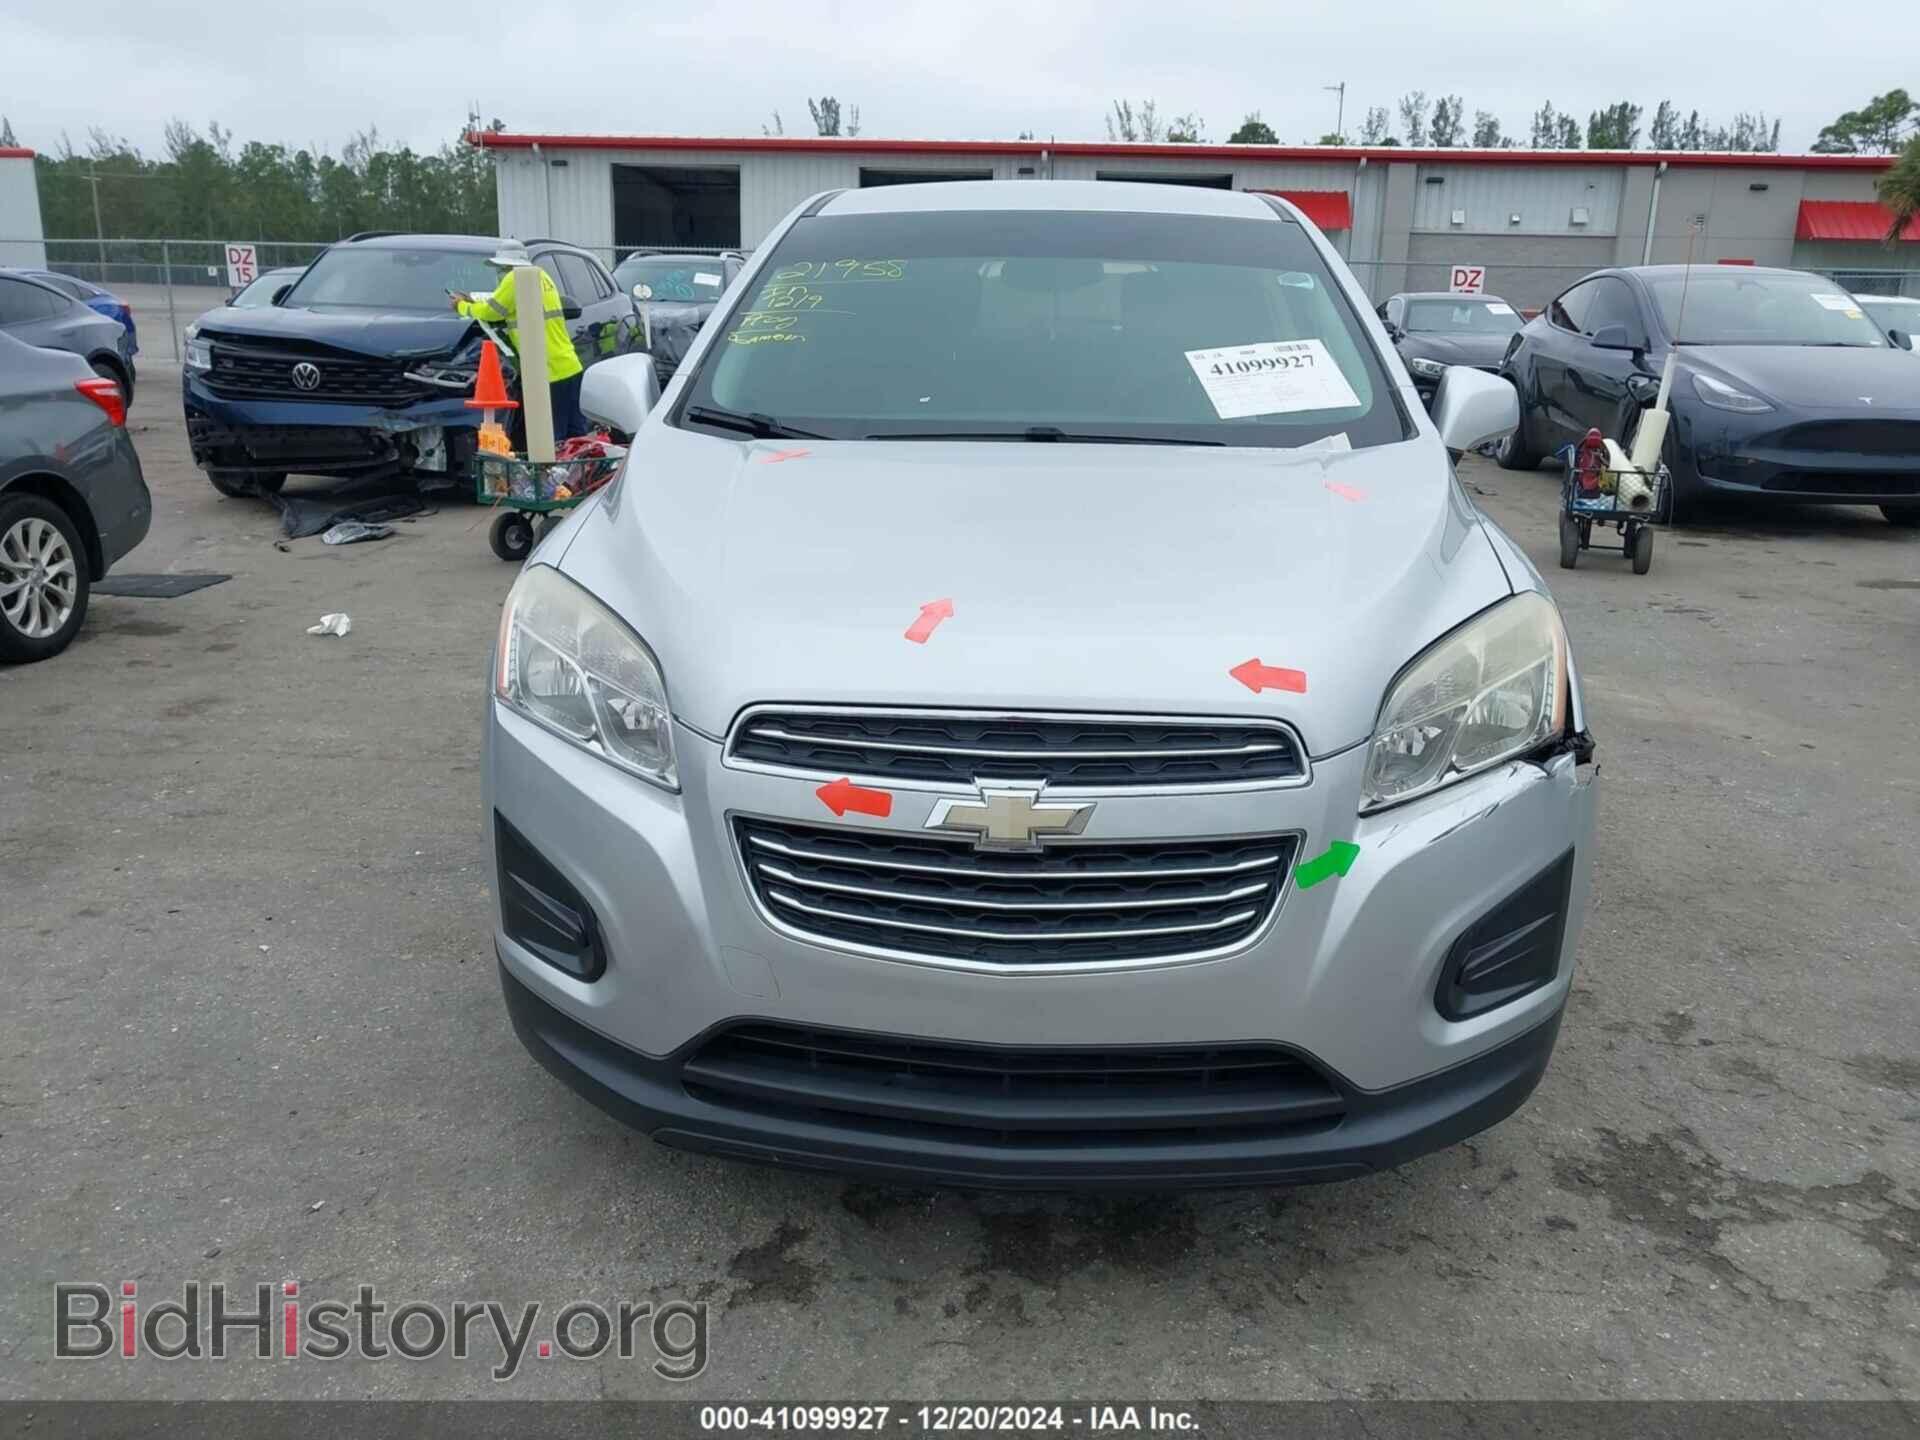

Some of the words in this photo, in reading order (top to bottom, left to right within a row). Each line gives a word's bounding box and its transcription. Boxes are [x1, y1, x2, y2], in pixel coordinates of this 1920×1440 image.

[228, 248, 254, 265] DZ
[235, 267, 252, 284] 15
[1453, 269, 1482, 287] DZ
[1210, 354, 1316, 377] 41099927
